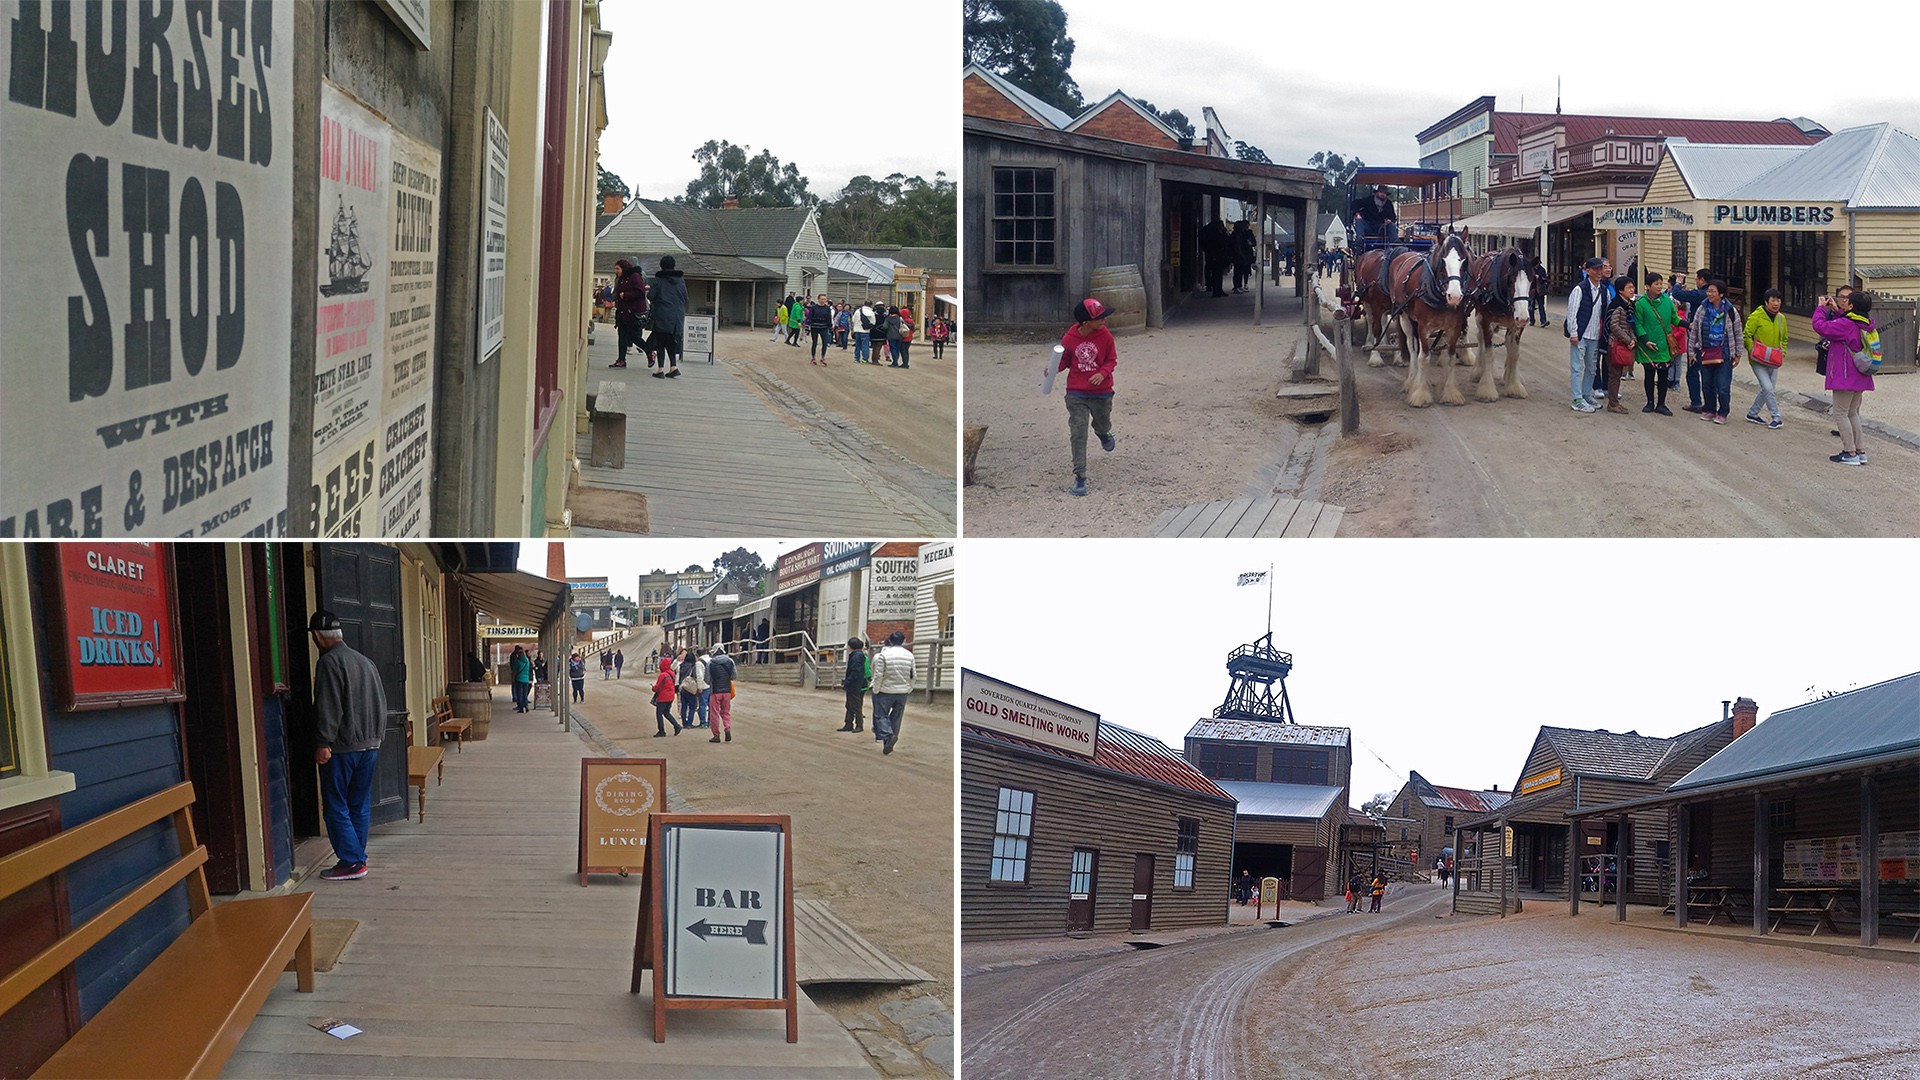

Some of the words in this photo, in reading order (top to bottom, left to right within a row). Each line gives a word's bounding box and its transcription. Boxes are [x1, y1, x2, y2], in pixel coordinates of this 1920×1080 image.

[321, 115, 342, 183] RED
[395, 190, 433, 252] PRINTING
[1615, 207, 1645, 225] CLARKE
[1715, 205, 1835, 224] PLUMBERS
[66, 153, 245, 402] SHOD
[339, 360, 355, 382] STAR
[358, 353, 372, 374] LINE
[97, 393, 229, 449] WITH
[343, 400, 369, 420] TRAIN
[386, 402, 426, 452] CRICKET
[0, 485, 103, 538] ARE
[124, 470, 146, 532] &
[163, 420, 273, 515] DESPATCH
[380, 431, 428, 498] CRICKET
[201, 497, 252, 536] MOST
[87, 550, 145, 581] CLARET
[779, 565, 791, 577] BOOT
[794, 560, 807, 572] SHOE
[784, 546, 816, 566] EDINBURGH
[826, 566, 835, 576] OIL
[835, 556, 861, 573] COMPANY
[923, 546, 954, 564] MECHAN
[876, 575, 889, 583] OIL
[891, 575, 918, 583] COMPA
[90, 606, 143, 637] ICED
[486, 627, 538, 636] TINSMITHS
[77, 618, 162, 667] DRINKS!
[966, 697, 998, 716] GOLD
[1001, 707, 1054, 733] SMELTING
[1056, 723, 1090, 744] WORKS
[980, 687, 1015, 704] SOVEREIGN
[1015, 699, 1037, 712] QUARTZ
[1038, 706, 1058, 718] MINING
[1058, 712, 1082, 725] COMPANY
[600, 837, 647, 846] LUNCH
[694, 887, 763, 910] BAR
[710, 925, 743, 936] HERE
